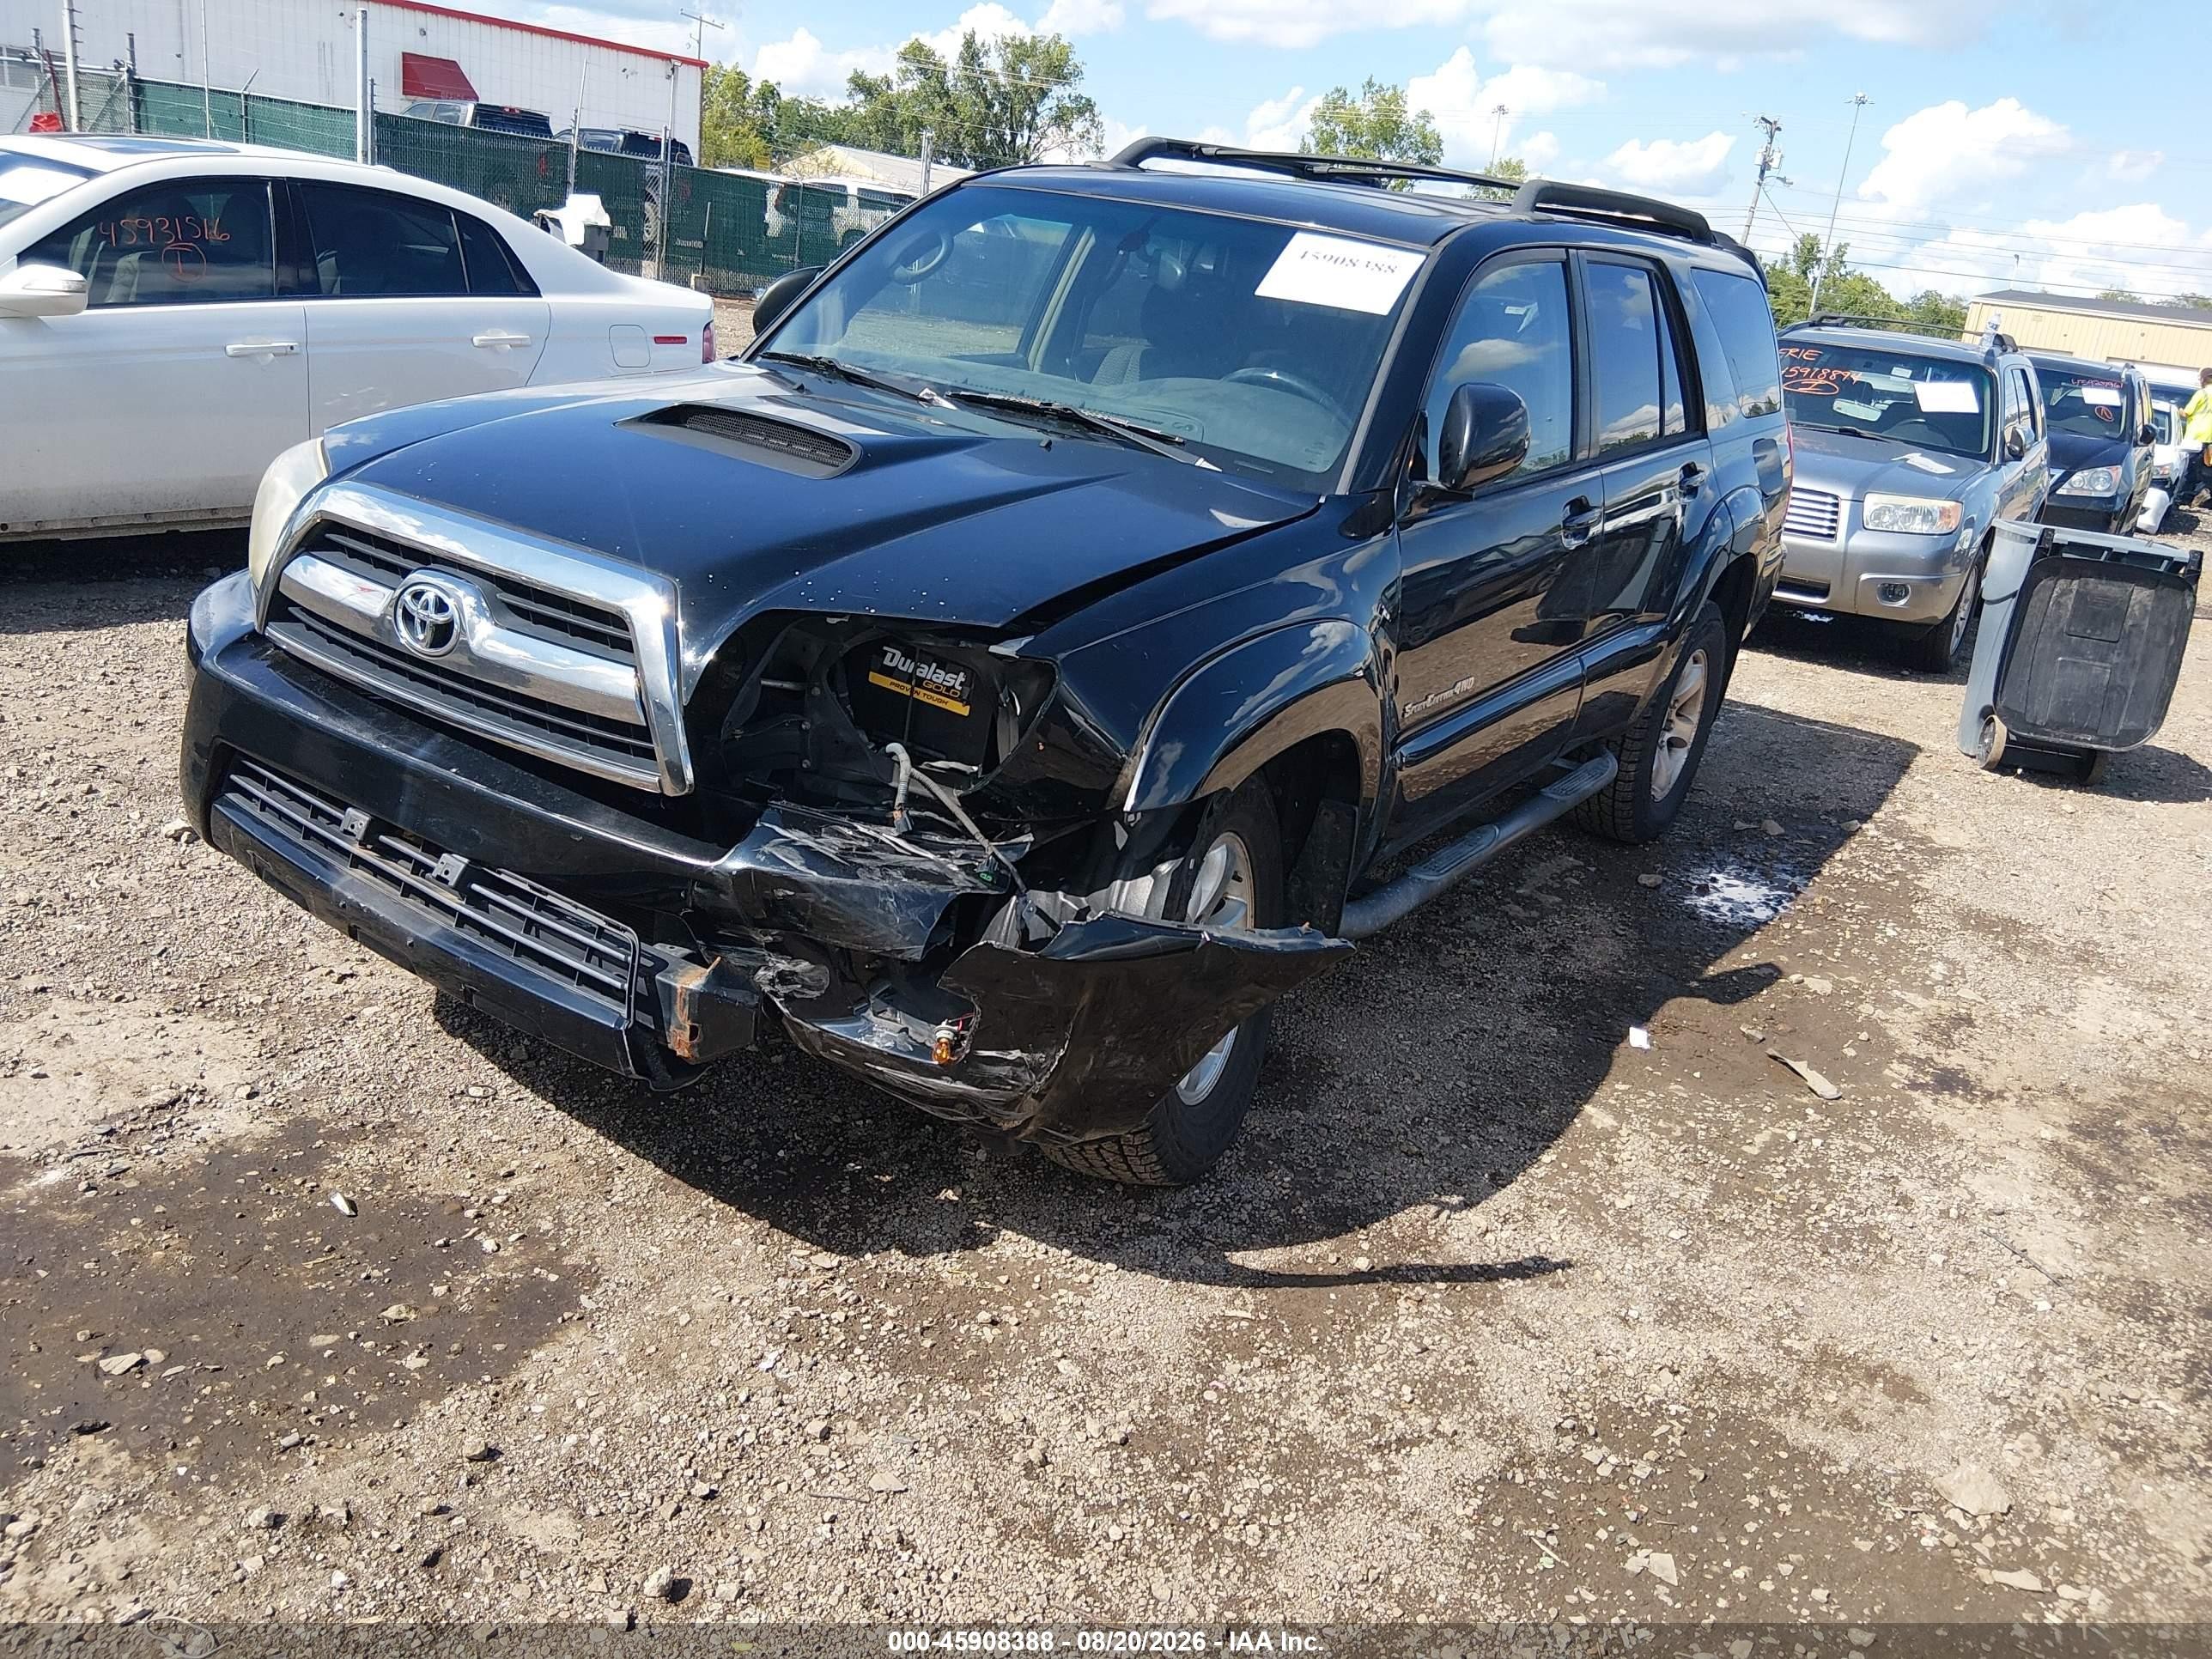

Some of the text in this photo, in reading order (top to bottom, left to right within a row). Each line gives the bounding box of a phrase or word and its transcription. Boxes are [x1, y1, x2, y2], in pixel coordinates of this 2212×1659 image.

[100, 216, 231, 246] 45931516
[883, 646, 967, 690] Duralast
[889, 681, 950, 707] PROVN TOUGH
[922, 680, 961, 698] GOLD
